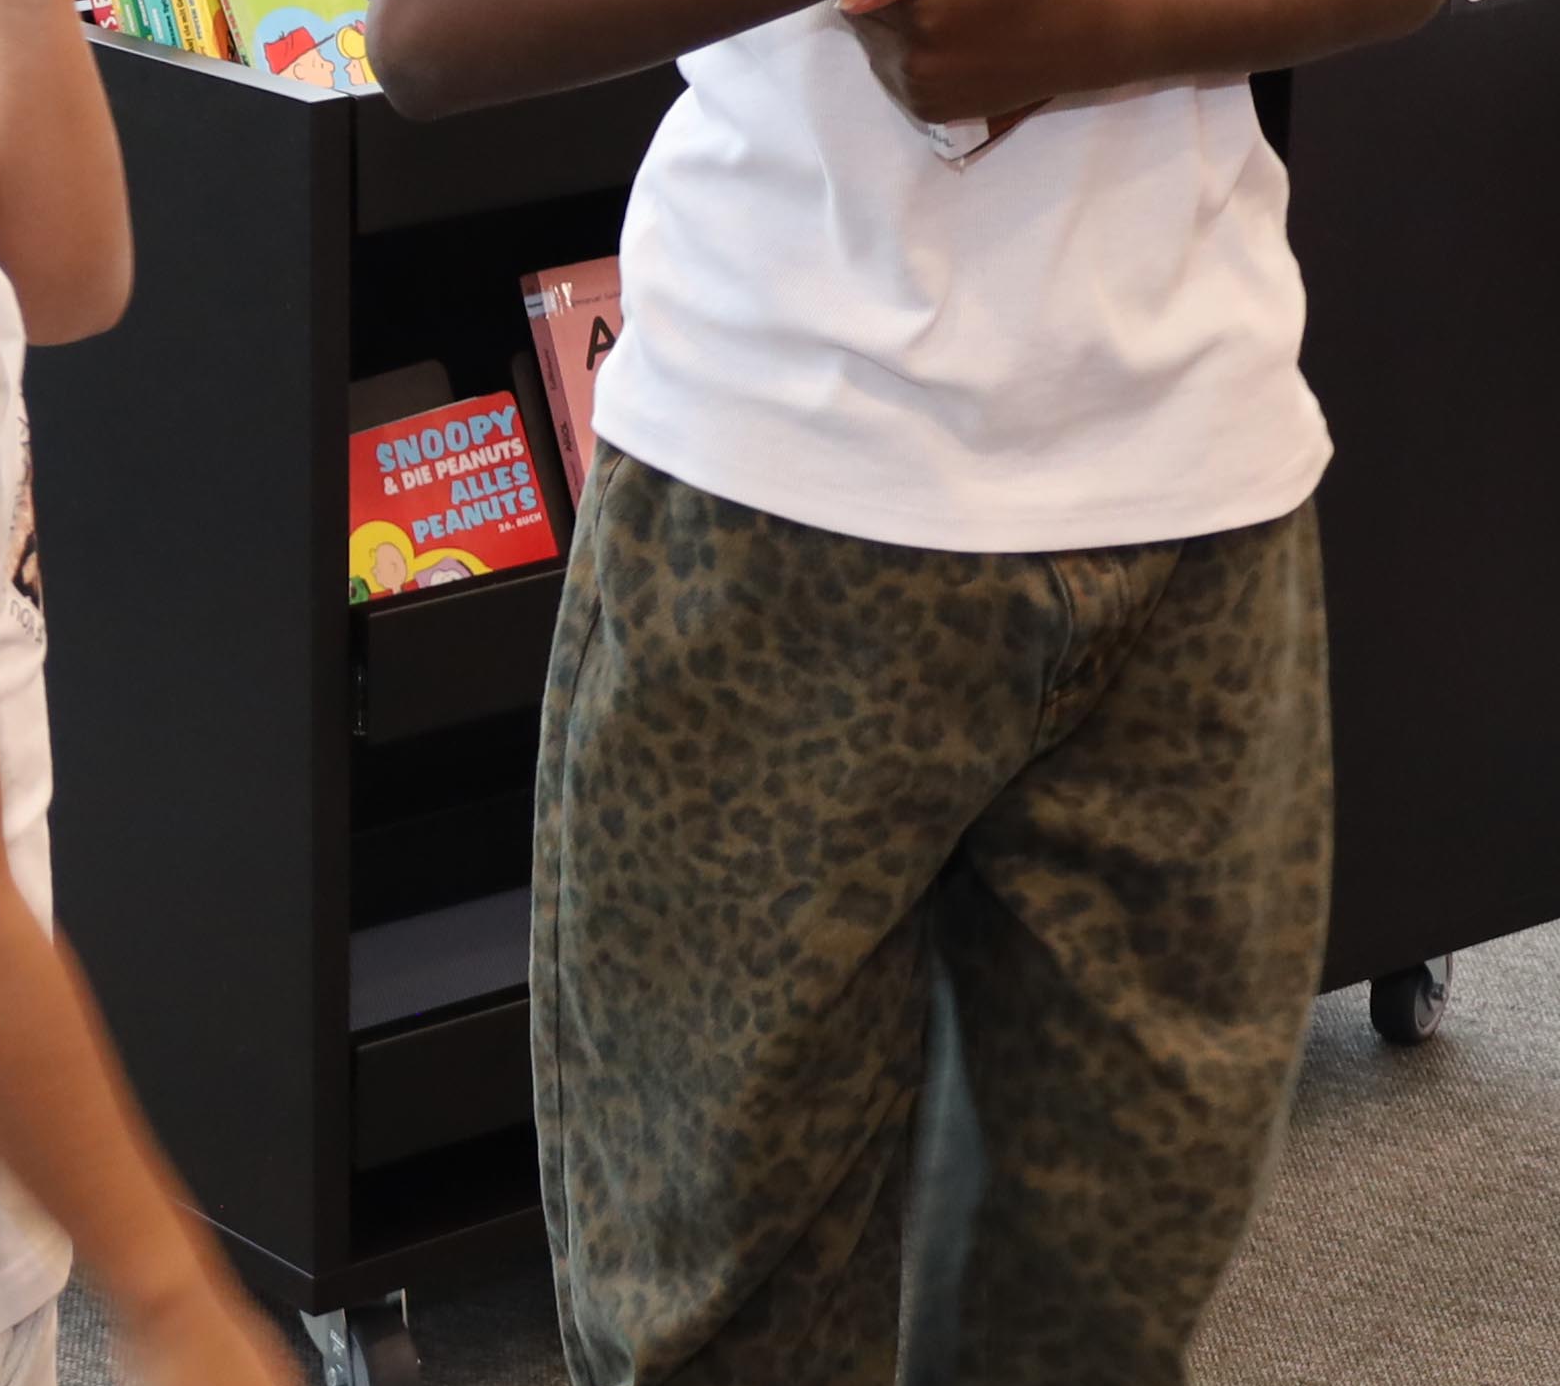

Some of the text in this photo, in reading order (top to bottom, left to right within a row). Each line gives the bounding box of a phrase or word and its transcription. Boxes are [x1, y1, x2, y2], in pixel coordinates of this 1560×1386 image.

[376, 404, 516, 473] SNOOPY
[383, 437, 524, 496] & DIE PEANUTS
[450, 462, 530, 505] ALLES
[412, 486, 537, 544] PEANUTS
[517, 512, 542, 530] BUCH
